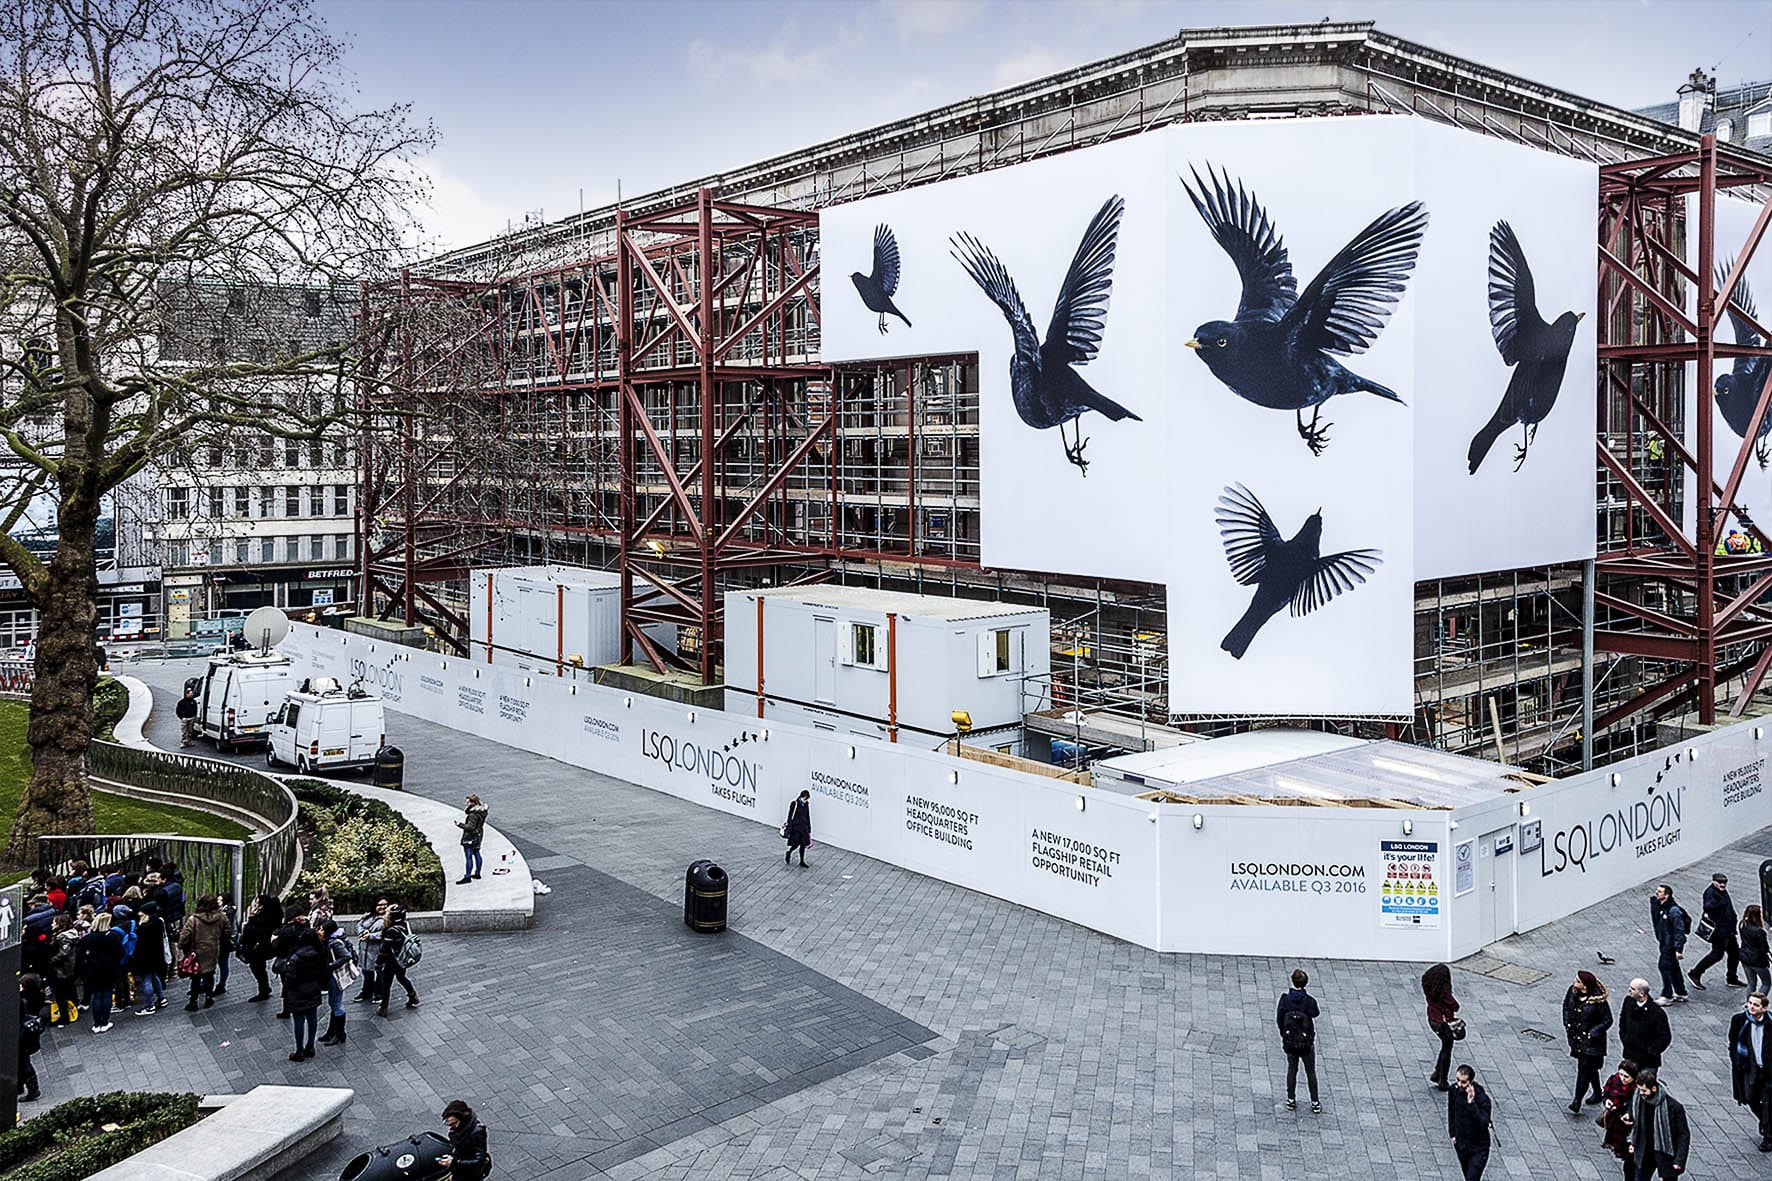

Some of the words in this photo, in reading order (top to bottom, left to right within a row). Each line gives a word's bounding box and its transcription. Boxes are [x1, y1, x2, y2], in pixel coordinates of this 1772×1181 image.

[308, 569, 353, 579] BETFRED
[711, 783, 731, 801] TAKES
[731, 792, 756, 809] FLIGHT
[811, 771, 869, 796] LSQLONDON.COM
[906, 795, 912, 804] A
[912, 796, 930, 810] NEW
[930, 801, 956, 818] 95,000
[957, 809, 969, 825] SQ
[969, 813, 979, 825] FT
[906, 807, 968, 836] HEADQUARTERS
[906, 819, 933, 838] OFFICE
[934, 829, 973, 851] BUILDING
[1032, 828, 1039, 839] A
[1040, 830, 1061, 845] NEW
[1062, 837, 1092, 856] 17,000
[1093, 846, 1108, 863] SQ
[1109, 851, 1121, 865] FT
[1635, 840, 1657, 858] TAKES
[1657, 829, 1681, 850] FLIGHT
[1032, 841, 1078, 865] FLAGSHIP
[1079, 856, 1112, 878] RETAIL
[1032, 856, 1100, 887] OPPORTUNITY
[1231, 862, 1365, 878] LSQLONDON.COM
[1383, 852, 1396, 861] it's
[1397, 854, 1416, 862] your
[1417, 853, 1435, 862] life!
[1230, 879, 1307, 892] AVAILABLE
[1311, 880, 1332, 895] Q3
[1335, 881, 1367, 894] 2016
